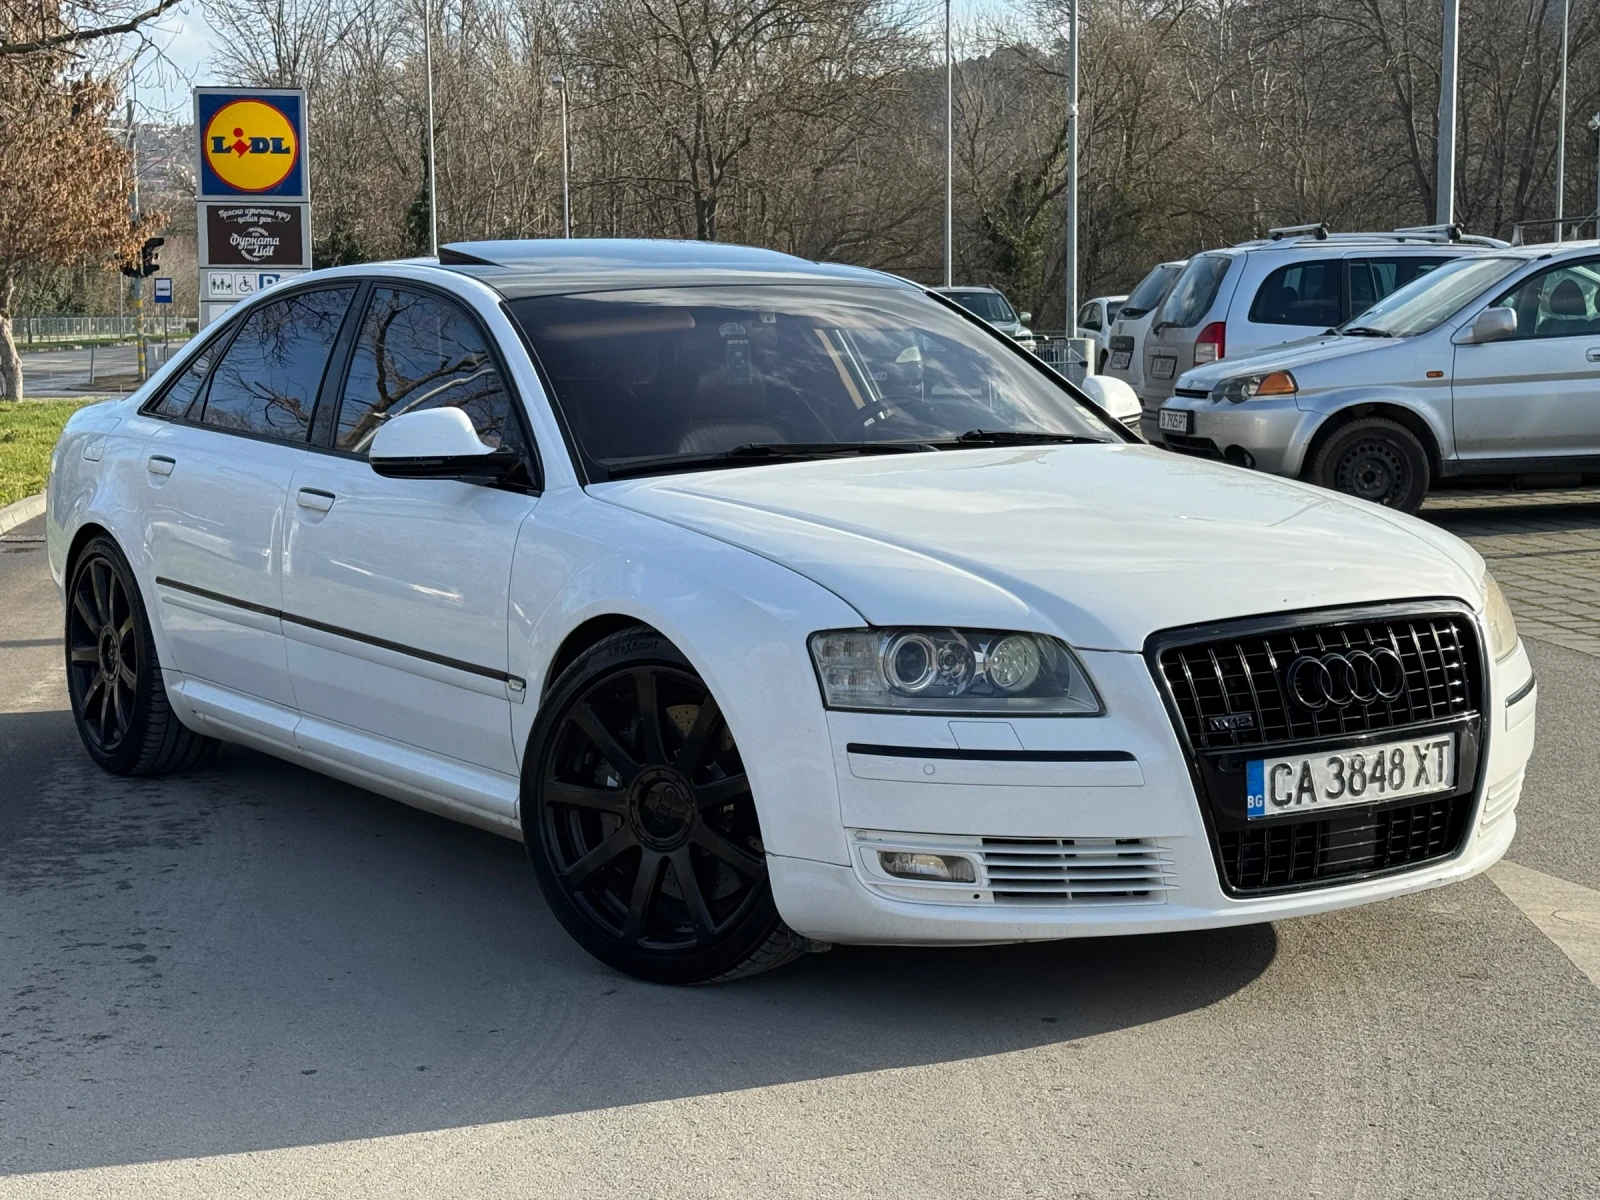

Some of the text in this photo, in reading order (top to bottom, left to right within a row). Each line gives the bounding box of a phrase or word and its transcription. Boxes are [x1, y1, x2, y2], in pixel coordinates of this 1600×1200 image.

[229, 232, 280, 250] Фурната
[252, 245, 275, 256] Lidl
[1270, 740, 1450, 808] CA 3848 XT
[1247, 795, 1263, 809] BG
